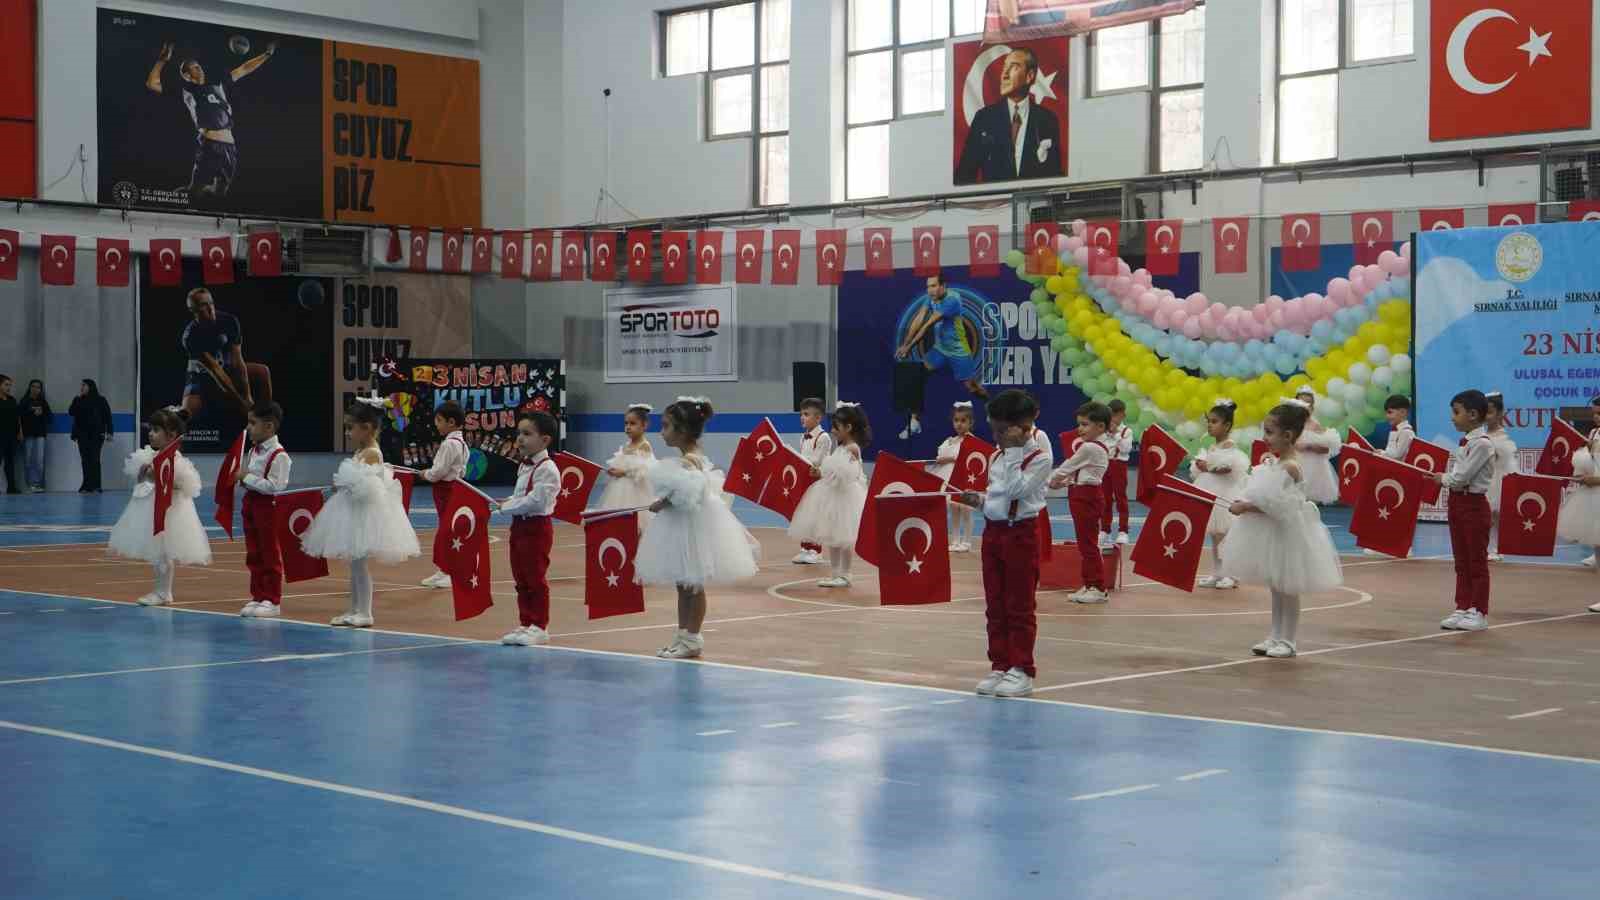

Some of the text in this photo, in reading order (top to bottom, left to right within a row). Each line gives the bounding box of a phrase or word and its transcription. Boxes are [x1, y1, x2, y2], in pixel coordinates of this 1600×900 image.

[334, 58, 397, 107] SPOR
[334, 112, 412, 162] CUYUZ
[343, 284, 398, 328] SPOR
[1565, 291, 1600, 303] SIRNA
[1522, 332, 1553, 355] 23
[453, 362, 528, 387] NİSAN
[983, 346, 1032, 385] HER
[1514, 368, 1563, 379] ULUSAL
[1535, 386, 1579, 400] ÇOCUK
